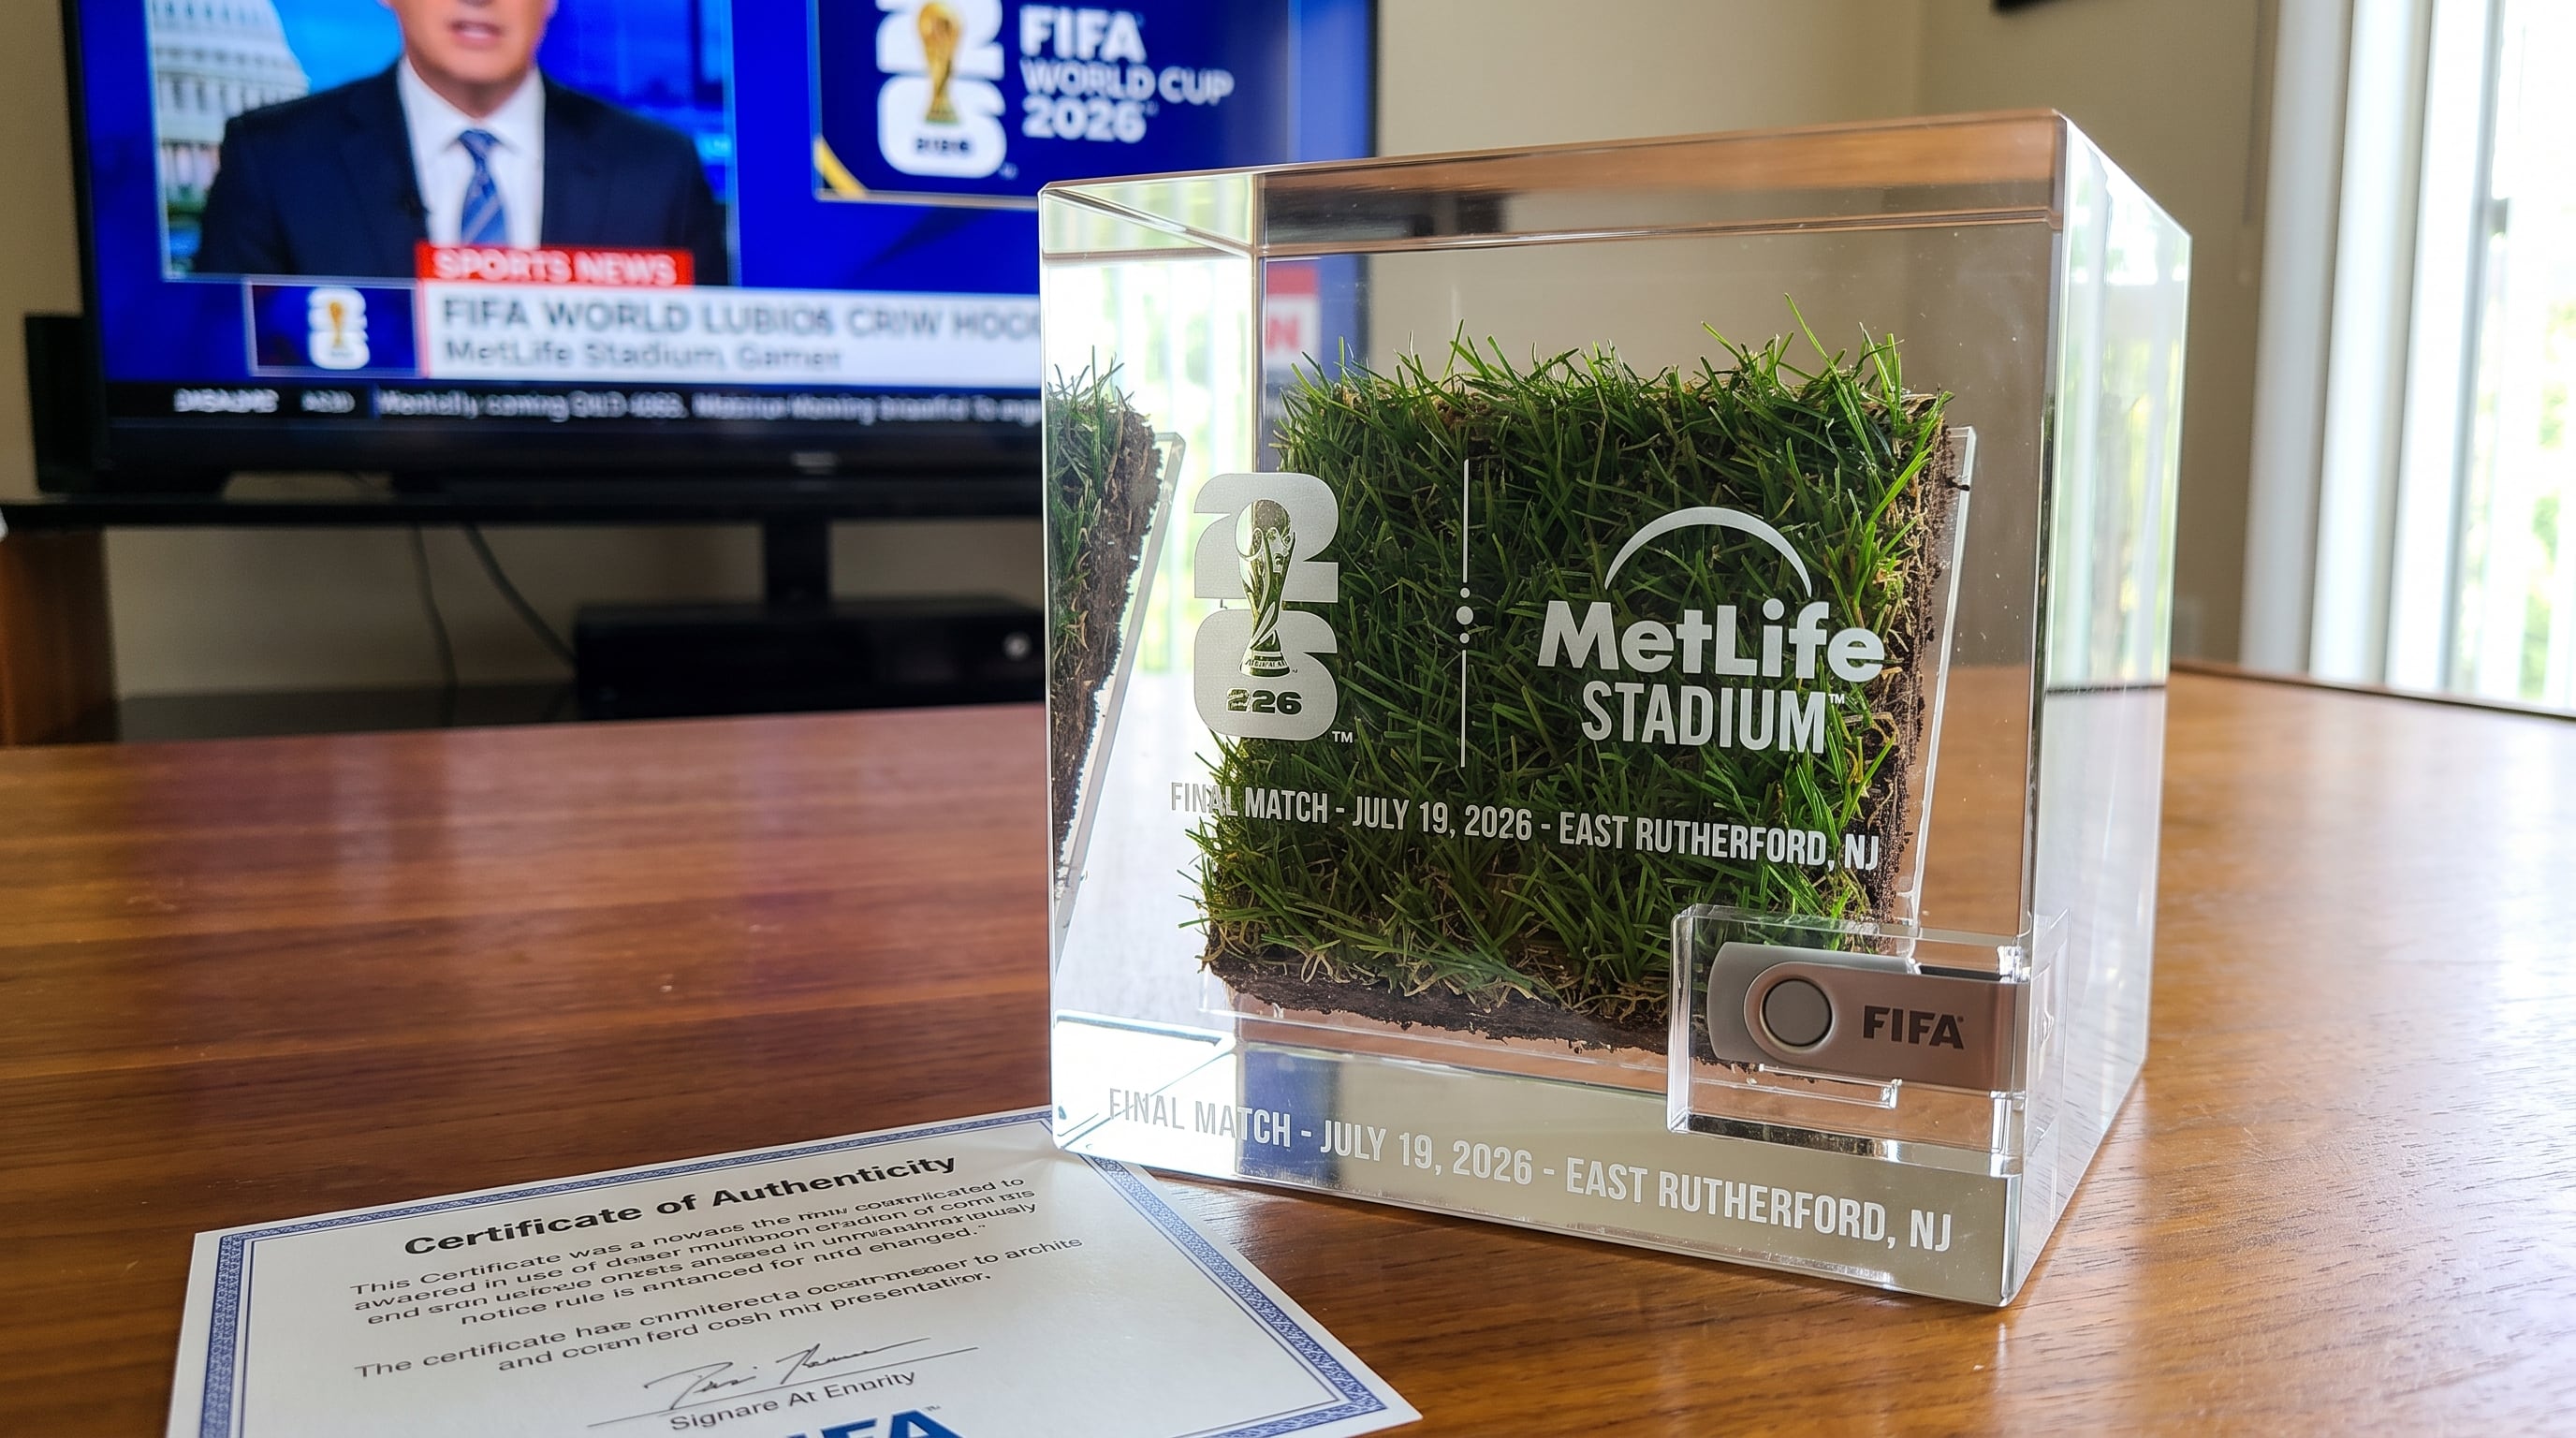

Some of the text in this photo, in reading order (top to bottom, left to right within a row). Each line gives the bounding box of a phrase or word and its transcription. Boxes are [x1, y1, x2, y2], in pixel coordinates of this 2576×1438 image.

[1019, 6, 1147, 63] FIFA
[1020, 59, 1235, 105] WORLD CUP
[1022, 95, 1147, 143] 2026
[432, 247, 677, 286] SPORTS NEWS
[444, 296, 528, 328] FIFA
[544, 299, 693, 332] WORLD
[444, 338, 571, 366] MetLife
[1537, 597, 1885, 683] MetLife
[1170, 781, 1238, 817] FINAL
[1244, 786, 1328, 824] MATCH
[1352, 796, 1410, 830] JULY
[1419, 800, 1456, 839] 19,
[1464, 804, 1532, 841] 2026
[1559, 811, 1629, 849] EAST
[1635, 816, 1836, 872] RUTHERFORD,
[1844, 833, 1880, 871] NJ
[1863, 1005, 1965, 1049] FIFA
[1109, 1088, 1185, 1130] FINAL
[1194, 1100, 1292, 1148] MATCH
[1320, 1120, 1387, 1162] JULY
[1398, 1132, 1442, 1176] 19,
[1453, 1139, 1533, 1186] 2026
[1566, 1156, 1648, 1204] EAST
[1659, 1169, 1895, 1250] RUTHERFORD,
[1910, 1210, 1952, 1252] NJ
[349, 1279, 410, 1295] This
[420, 1253, 562, 1284] Certificate
[569, 1244, 622, 1259] was
[629, 1240, 645, 1249] a
[752, 1216, 791, 1228] the
[1001, 1178, 1024, 1188] to
[404, 1155, 956, 1255] Certificate of Authenticity
[355, 1281, 476, 1311] awaered
[485, 1278, 507, 1289] in
[517, 1269, 563, 1284] use
[572, 1261, 597, 1274] of
[914, 1205, 934, 1216] of
[368, 1306, 419, 1324] end
[794, 1240, 815, 1251] in
[354, 1358, 412, 1378] The
[422, 1331, 566, 1367] certificate
[973, 1254, 999, 1265] to
[461, 1301, 547, 1325] notice
[555, 1292, 605, 1309] rule
[613, 1286, 635, 1298] is
[770, 1257, 805, 1269] for
[498, 1350, 552, 1372] and
[708, 1310, 772, 1333] cosh
[789, 1391, 817, 1407] At
